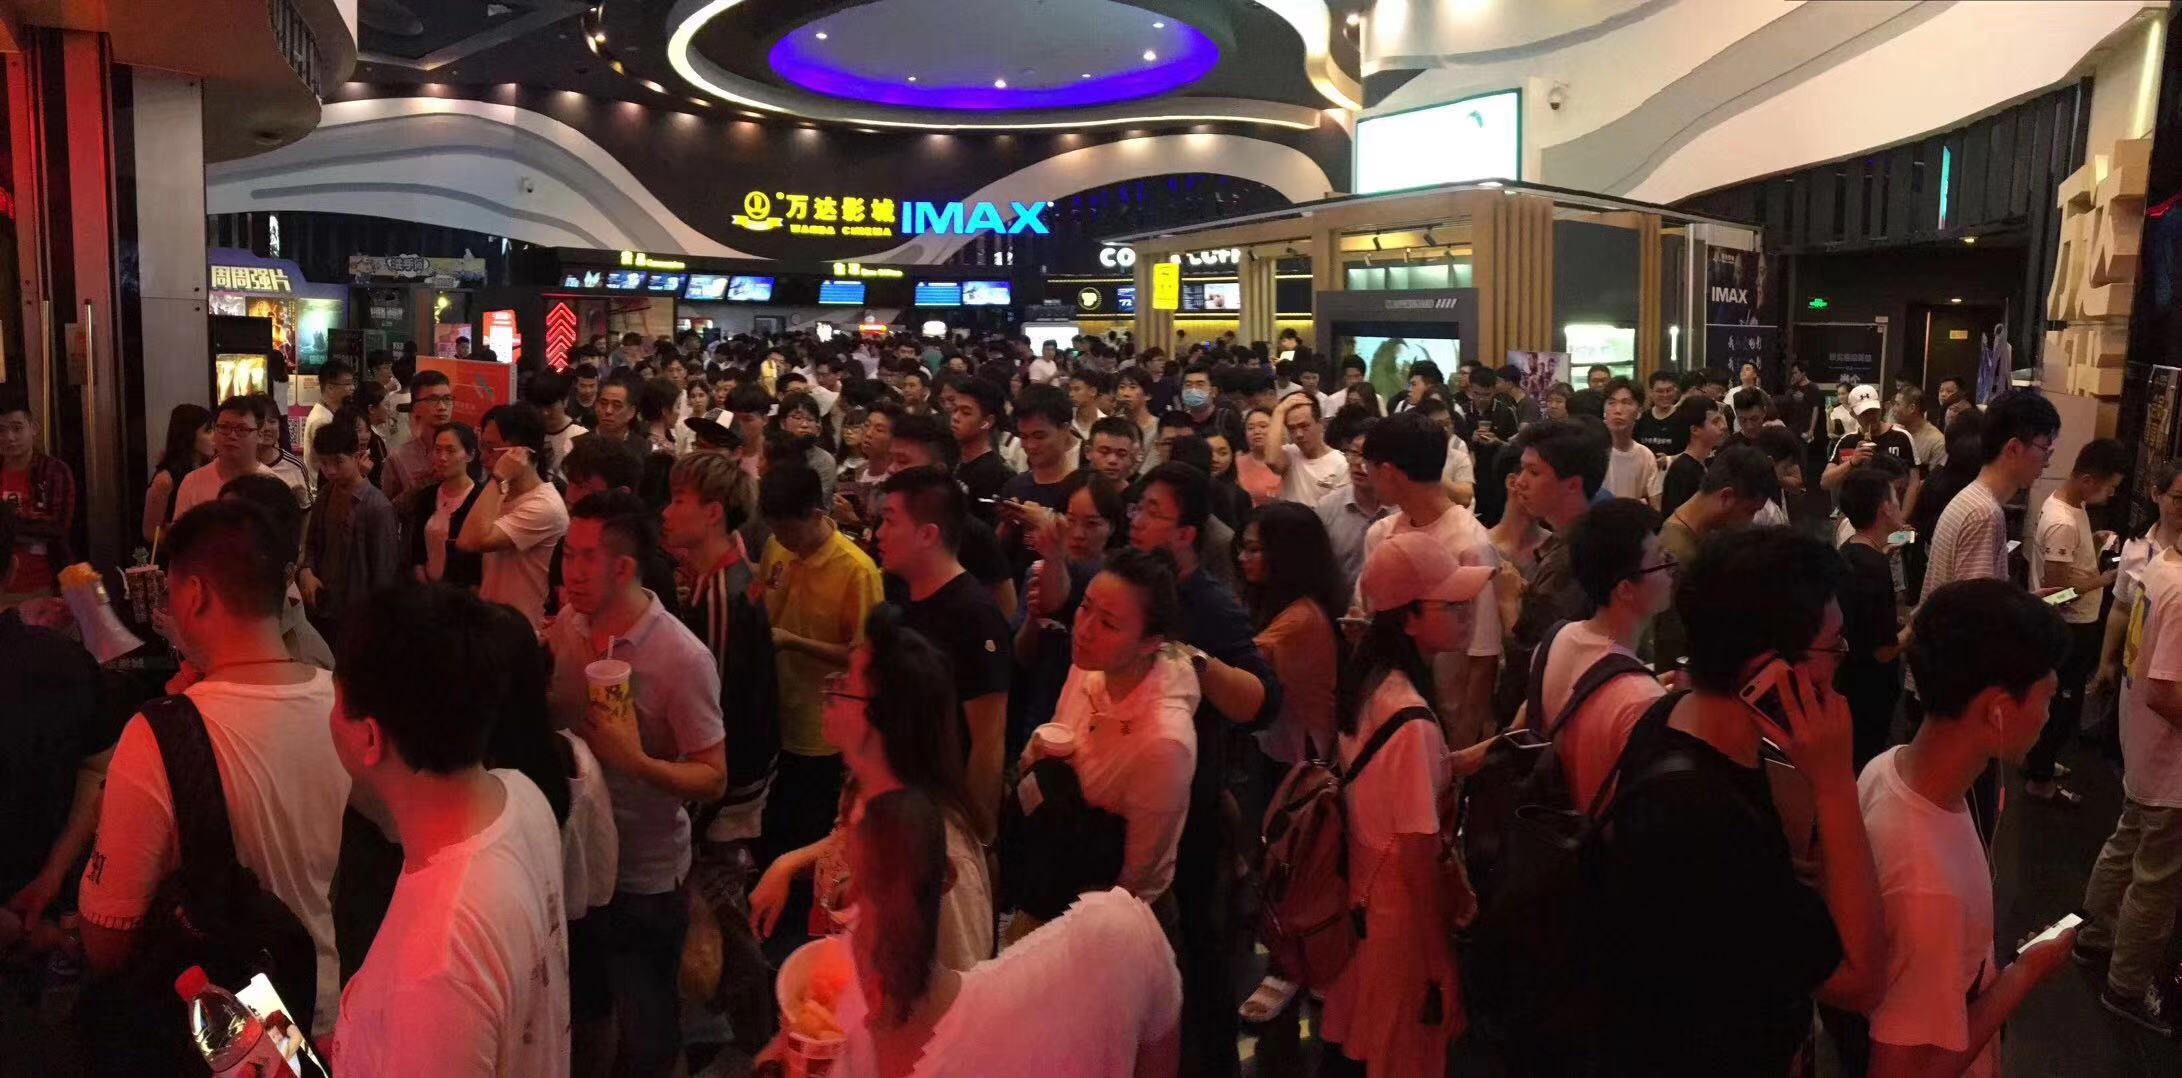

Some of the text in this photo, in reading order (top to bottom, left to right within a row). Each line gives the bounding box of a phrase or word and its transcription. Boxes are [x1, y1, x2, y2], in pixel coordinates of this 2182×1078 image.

[786, 194, 895, 222] 万达影城
[902, 201, 1049, 234] IMAX
[211, 265, 291, 292] 周周强片
[1711, 286, 1748, 304] IMAX
